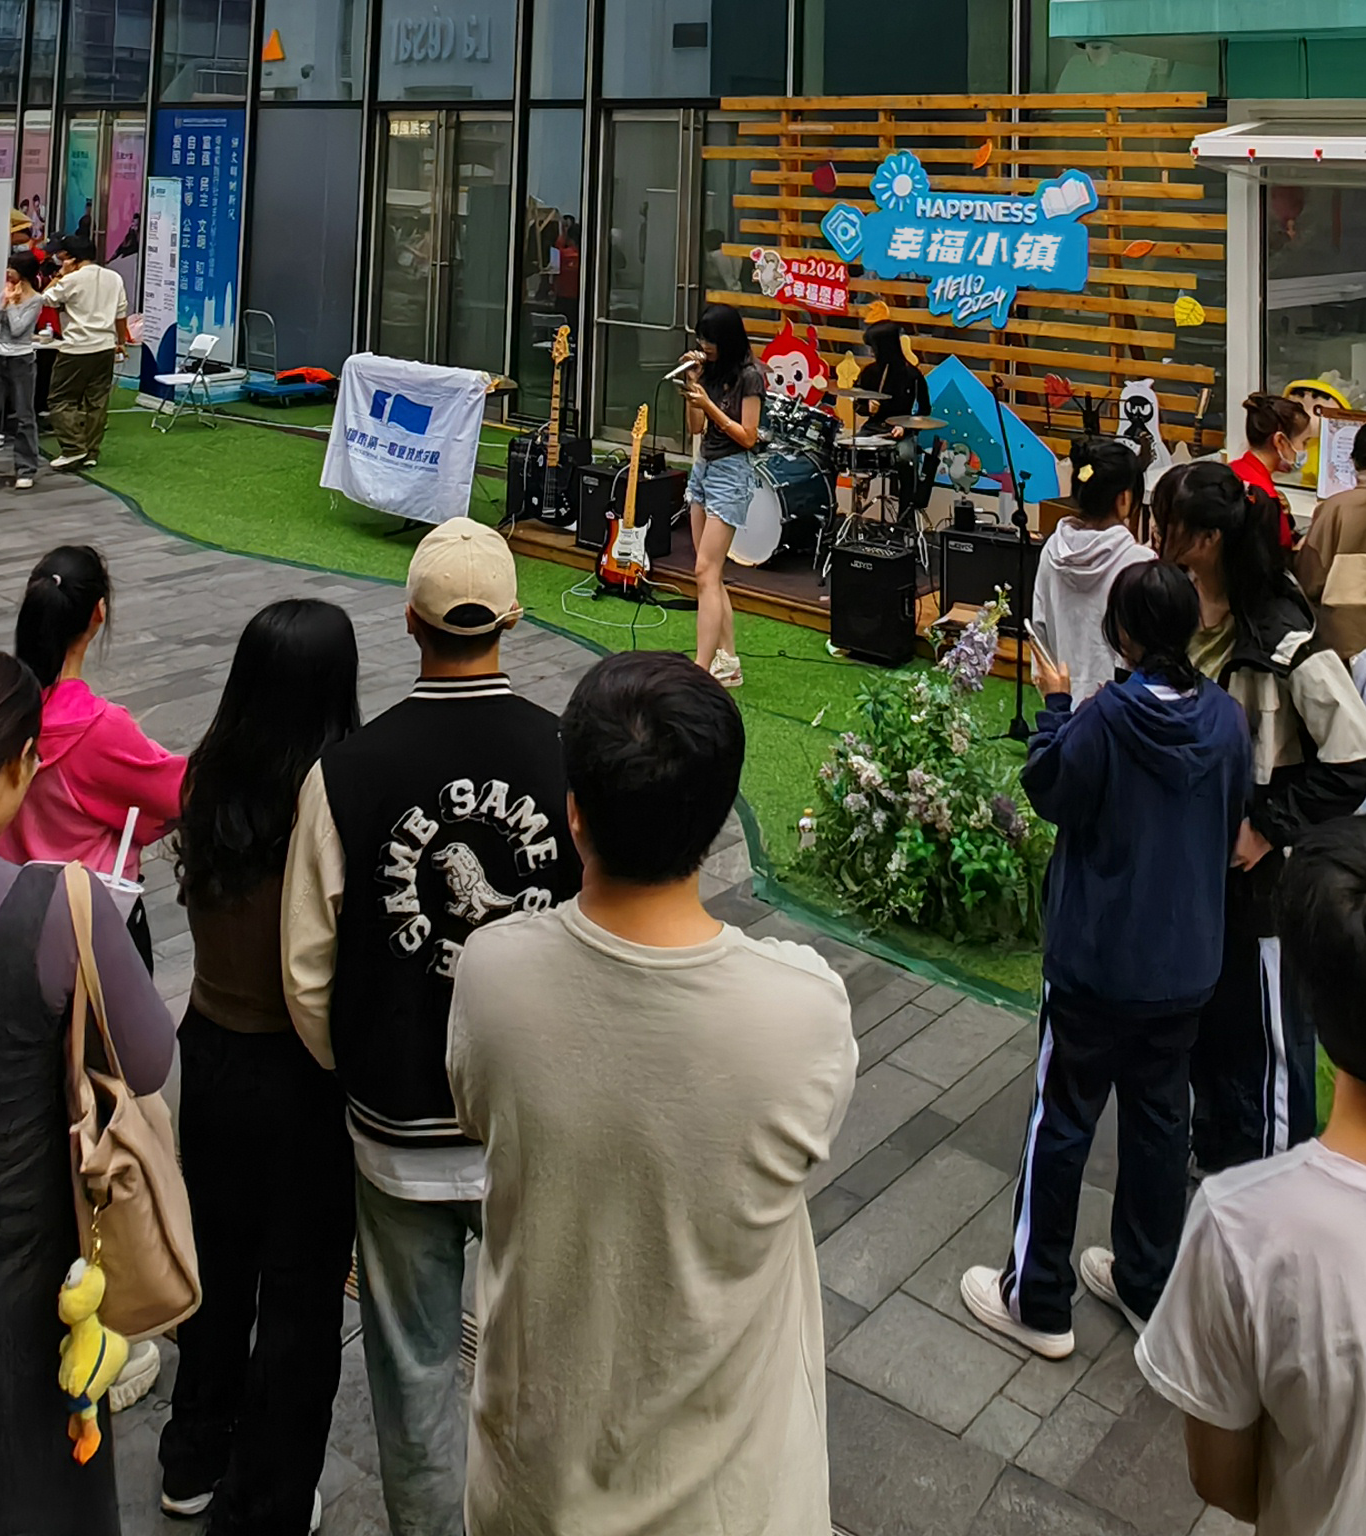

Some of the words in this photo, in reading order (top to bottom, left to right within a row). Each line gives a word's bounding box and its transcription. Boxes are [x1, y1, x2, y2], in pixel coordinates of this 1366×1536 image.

[915, 197, 1037, 224] HAPPINESS
[887, 226, 1063, 273] 幸福小镇
[807, 259, 846, 283] 2024
[932, 274, 985, 304] HELLO
[956, 285, 1008, 321] 2024
[439, 778, 558, 874] SAME
